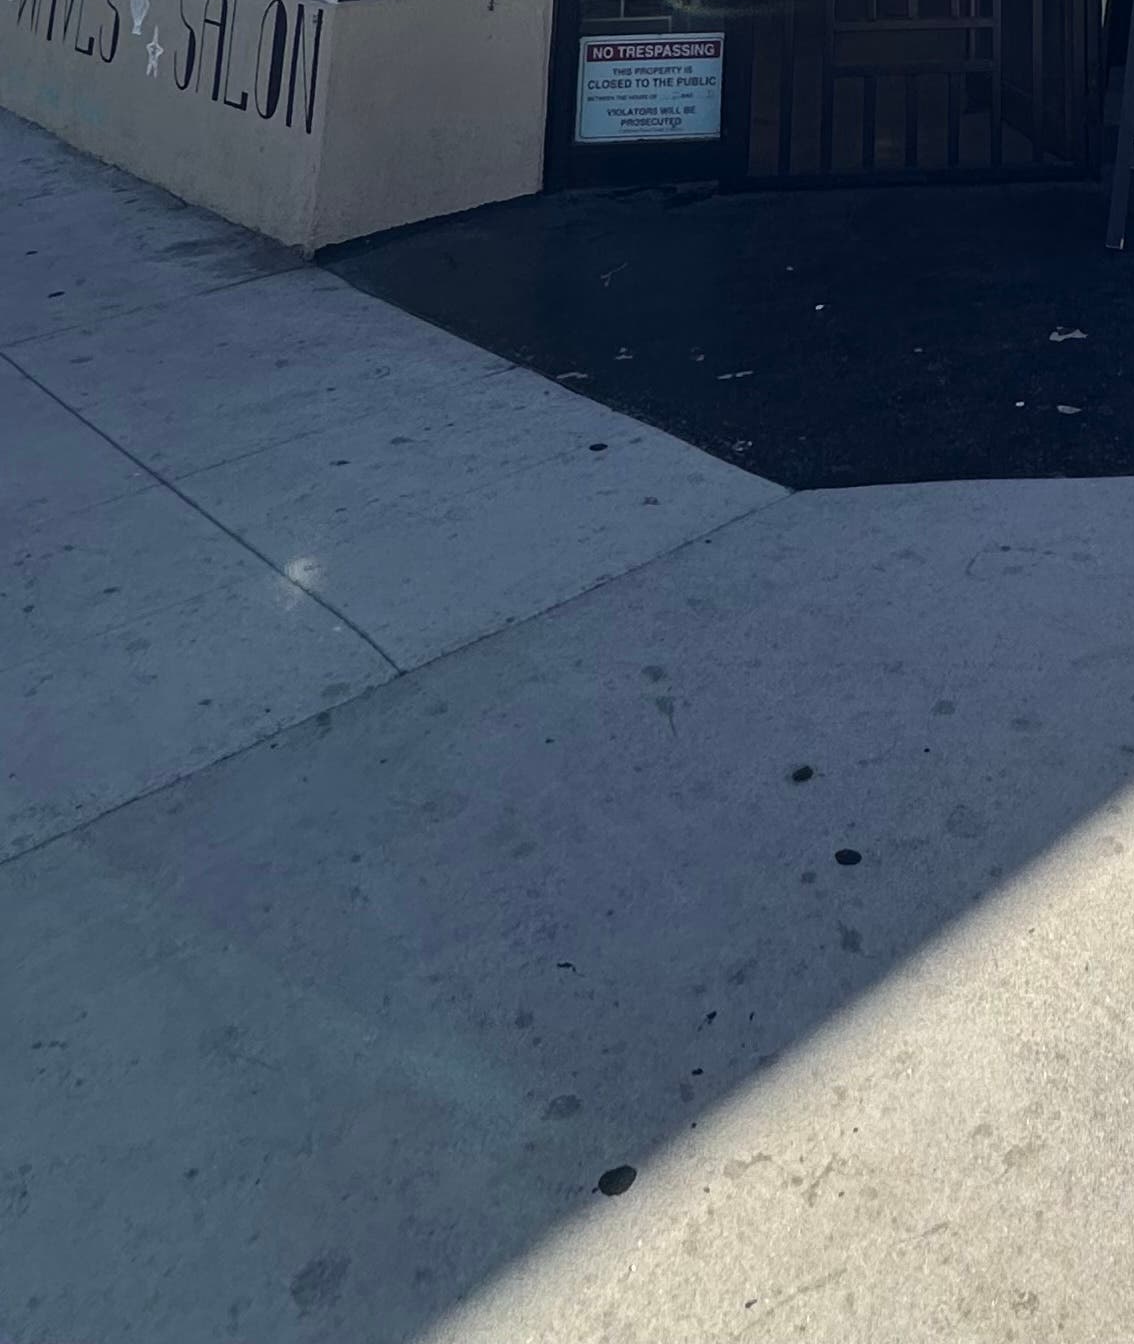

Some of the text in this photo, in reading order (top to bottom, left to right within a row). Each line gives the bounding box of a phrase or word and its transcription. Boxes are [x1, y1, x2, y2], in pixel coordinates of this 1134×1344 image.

[592, 43, 715, 59] NO TRESPASSING
[613, 65, 693, 76] THIS PROPERTY IS
[587, 76, 717, 90] CLOSED TO THE PUBLIC
[607, 105, 696, 117] VIOLATORS WILL BE
[620, 117, 683, 129] PROSECUTED
